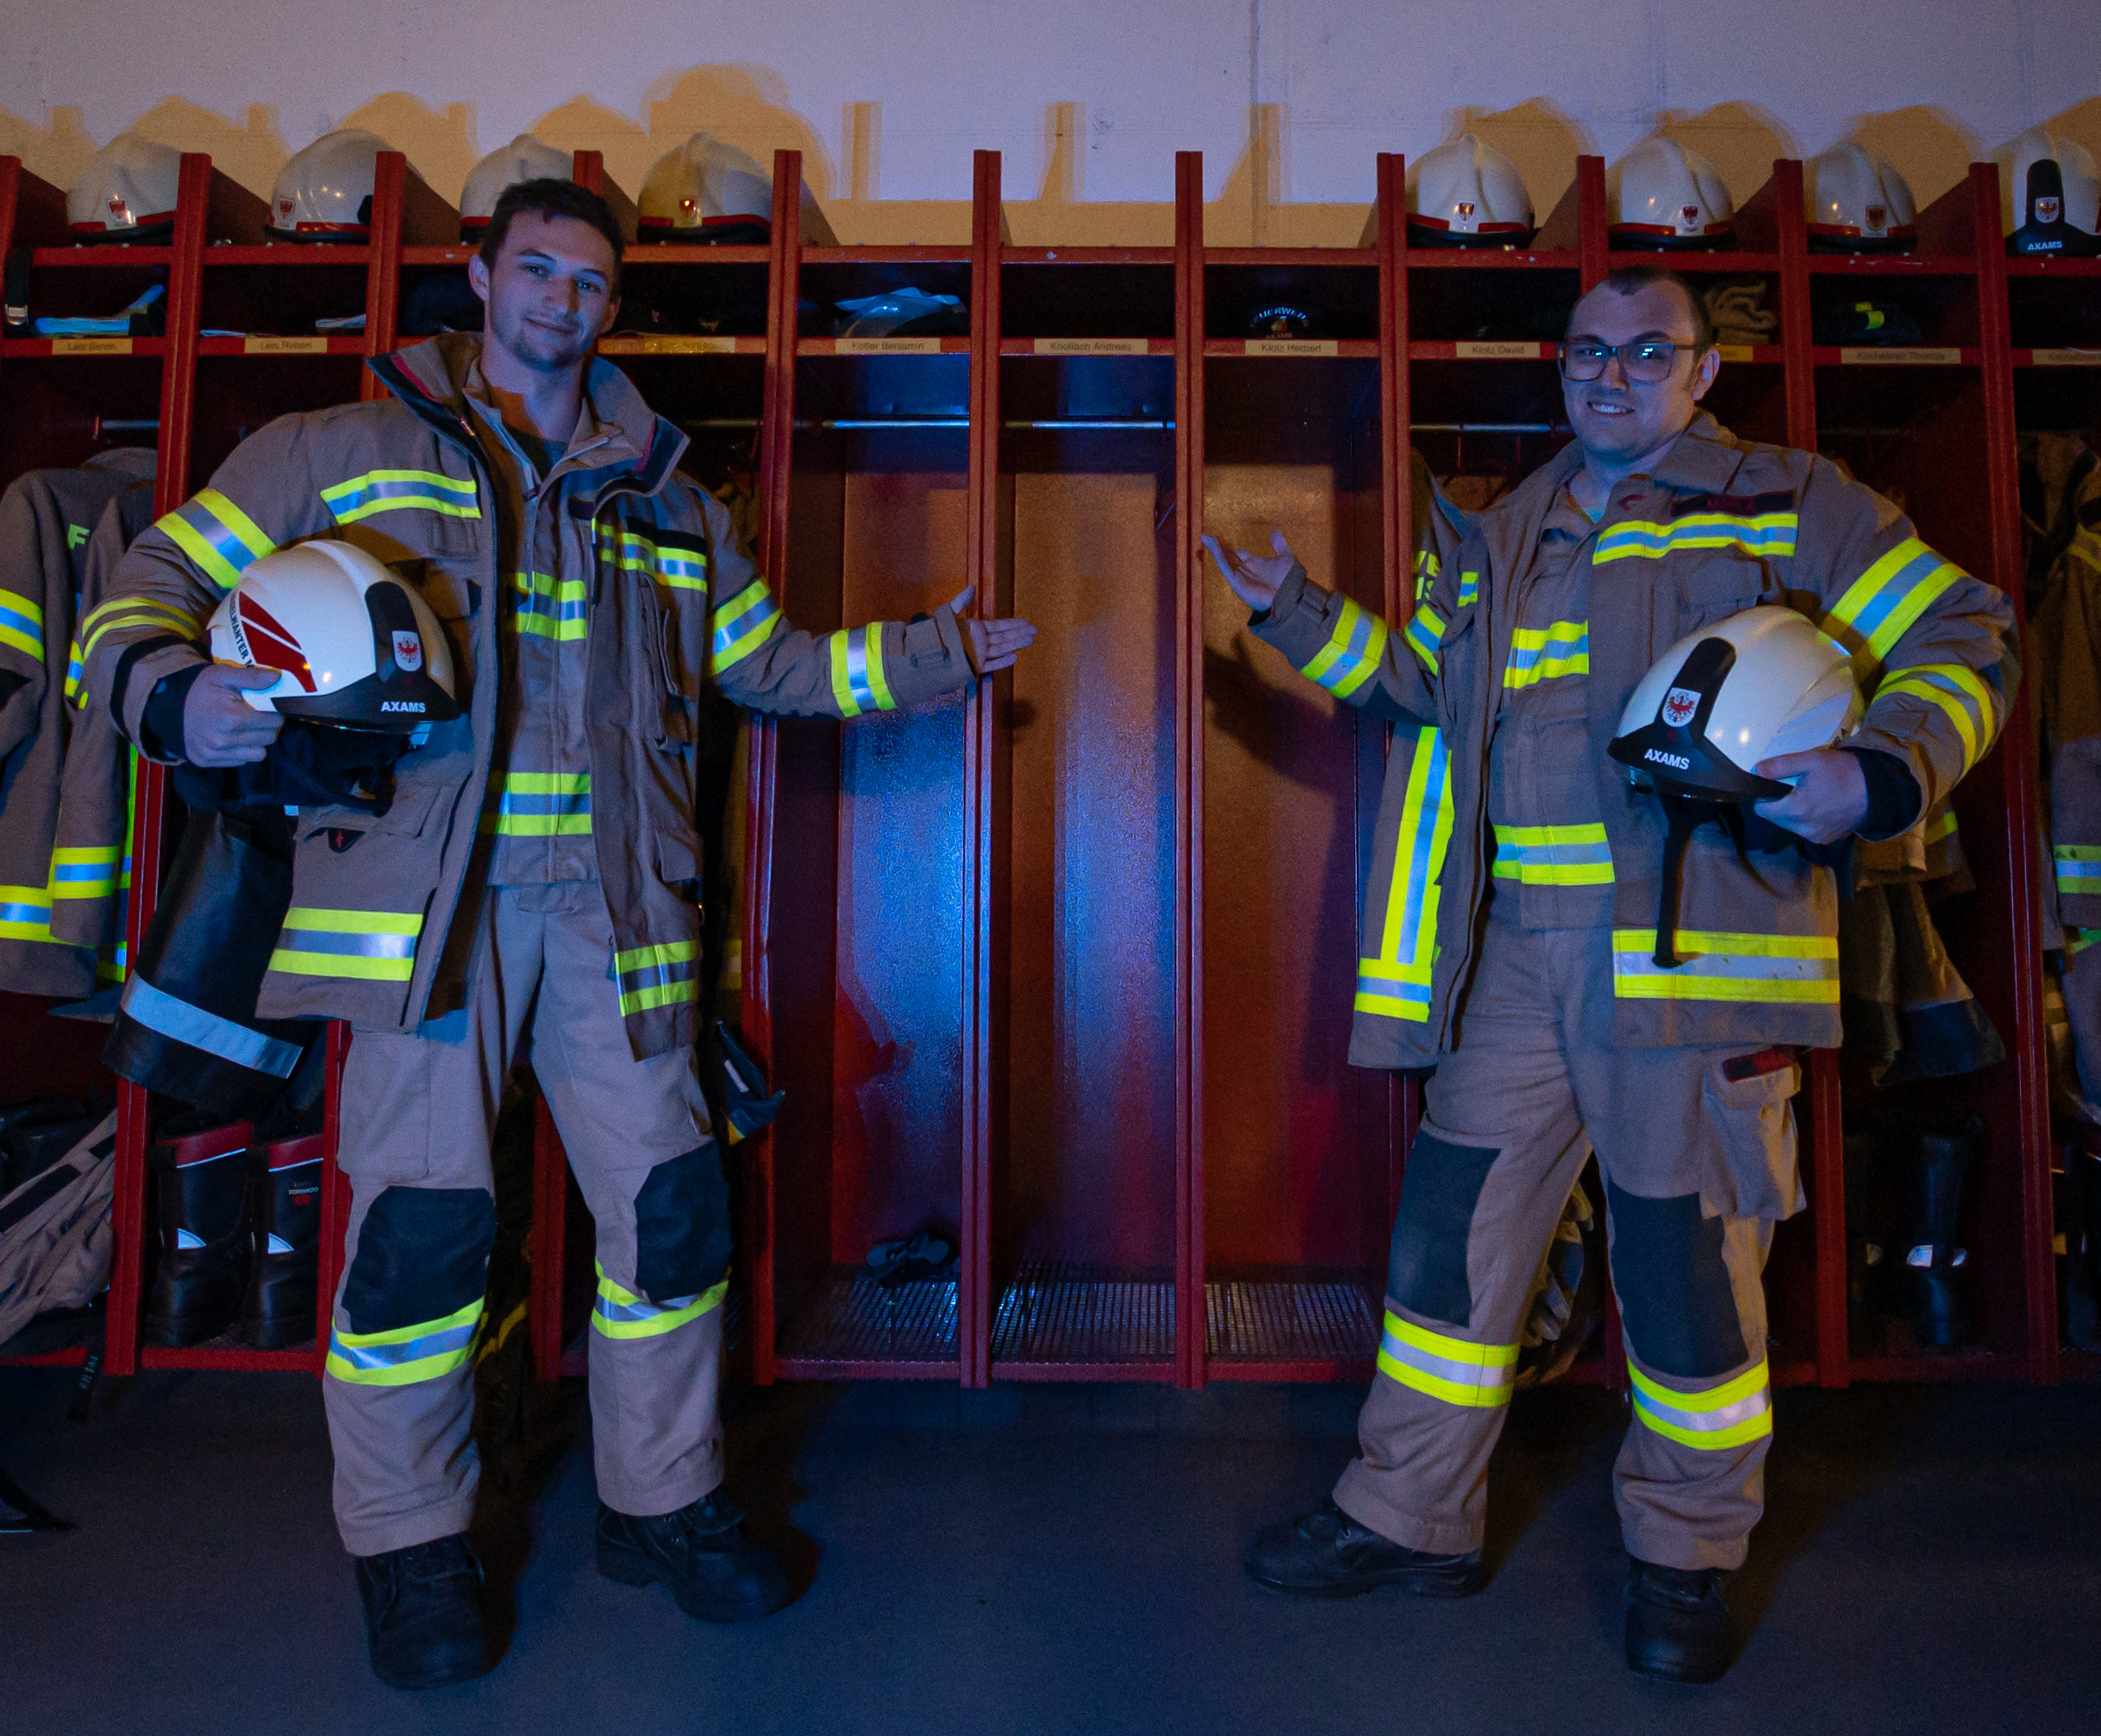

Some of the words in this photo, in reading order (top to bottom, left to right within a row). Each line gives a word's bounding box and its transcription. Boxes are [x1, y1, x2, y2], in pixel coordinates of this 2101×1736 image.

[2027, 240, 2063, 251] AXAMS
[881, 340, 925, 352] Benjamin
[1093, 341, 1132, 351] Andreas
[1261, 343, 1285, 352] Klotz
[1287, 344, 1322, 353] Herbert
[1473, 345, 1496, 354] Klotz
[1498, 346, 1525, 354] David
[380, 701, 426, 713] AXAMS
[1643, 748, 1691, 771] AXAMS
